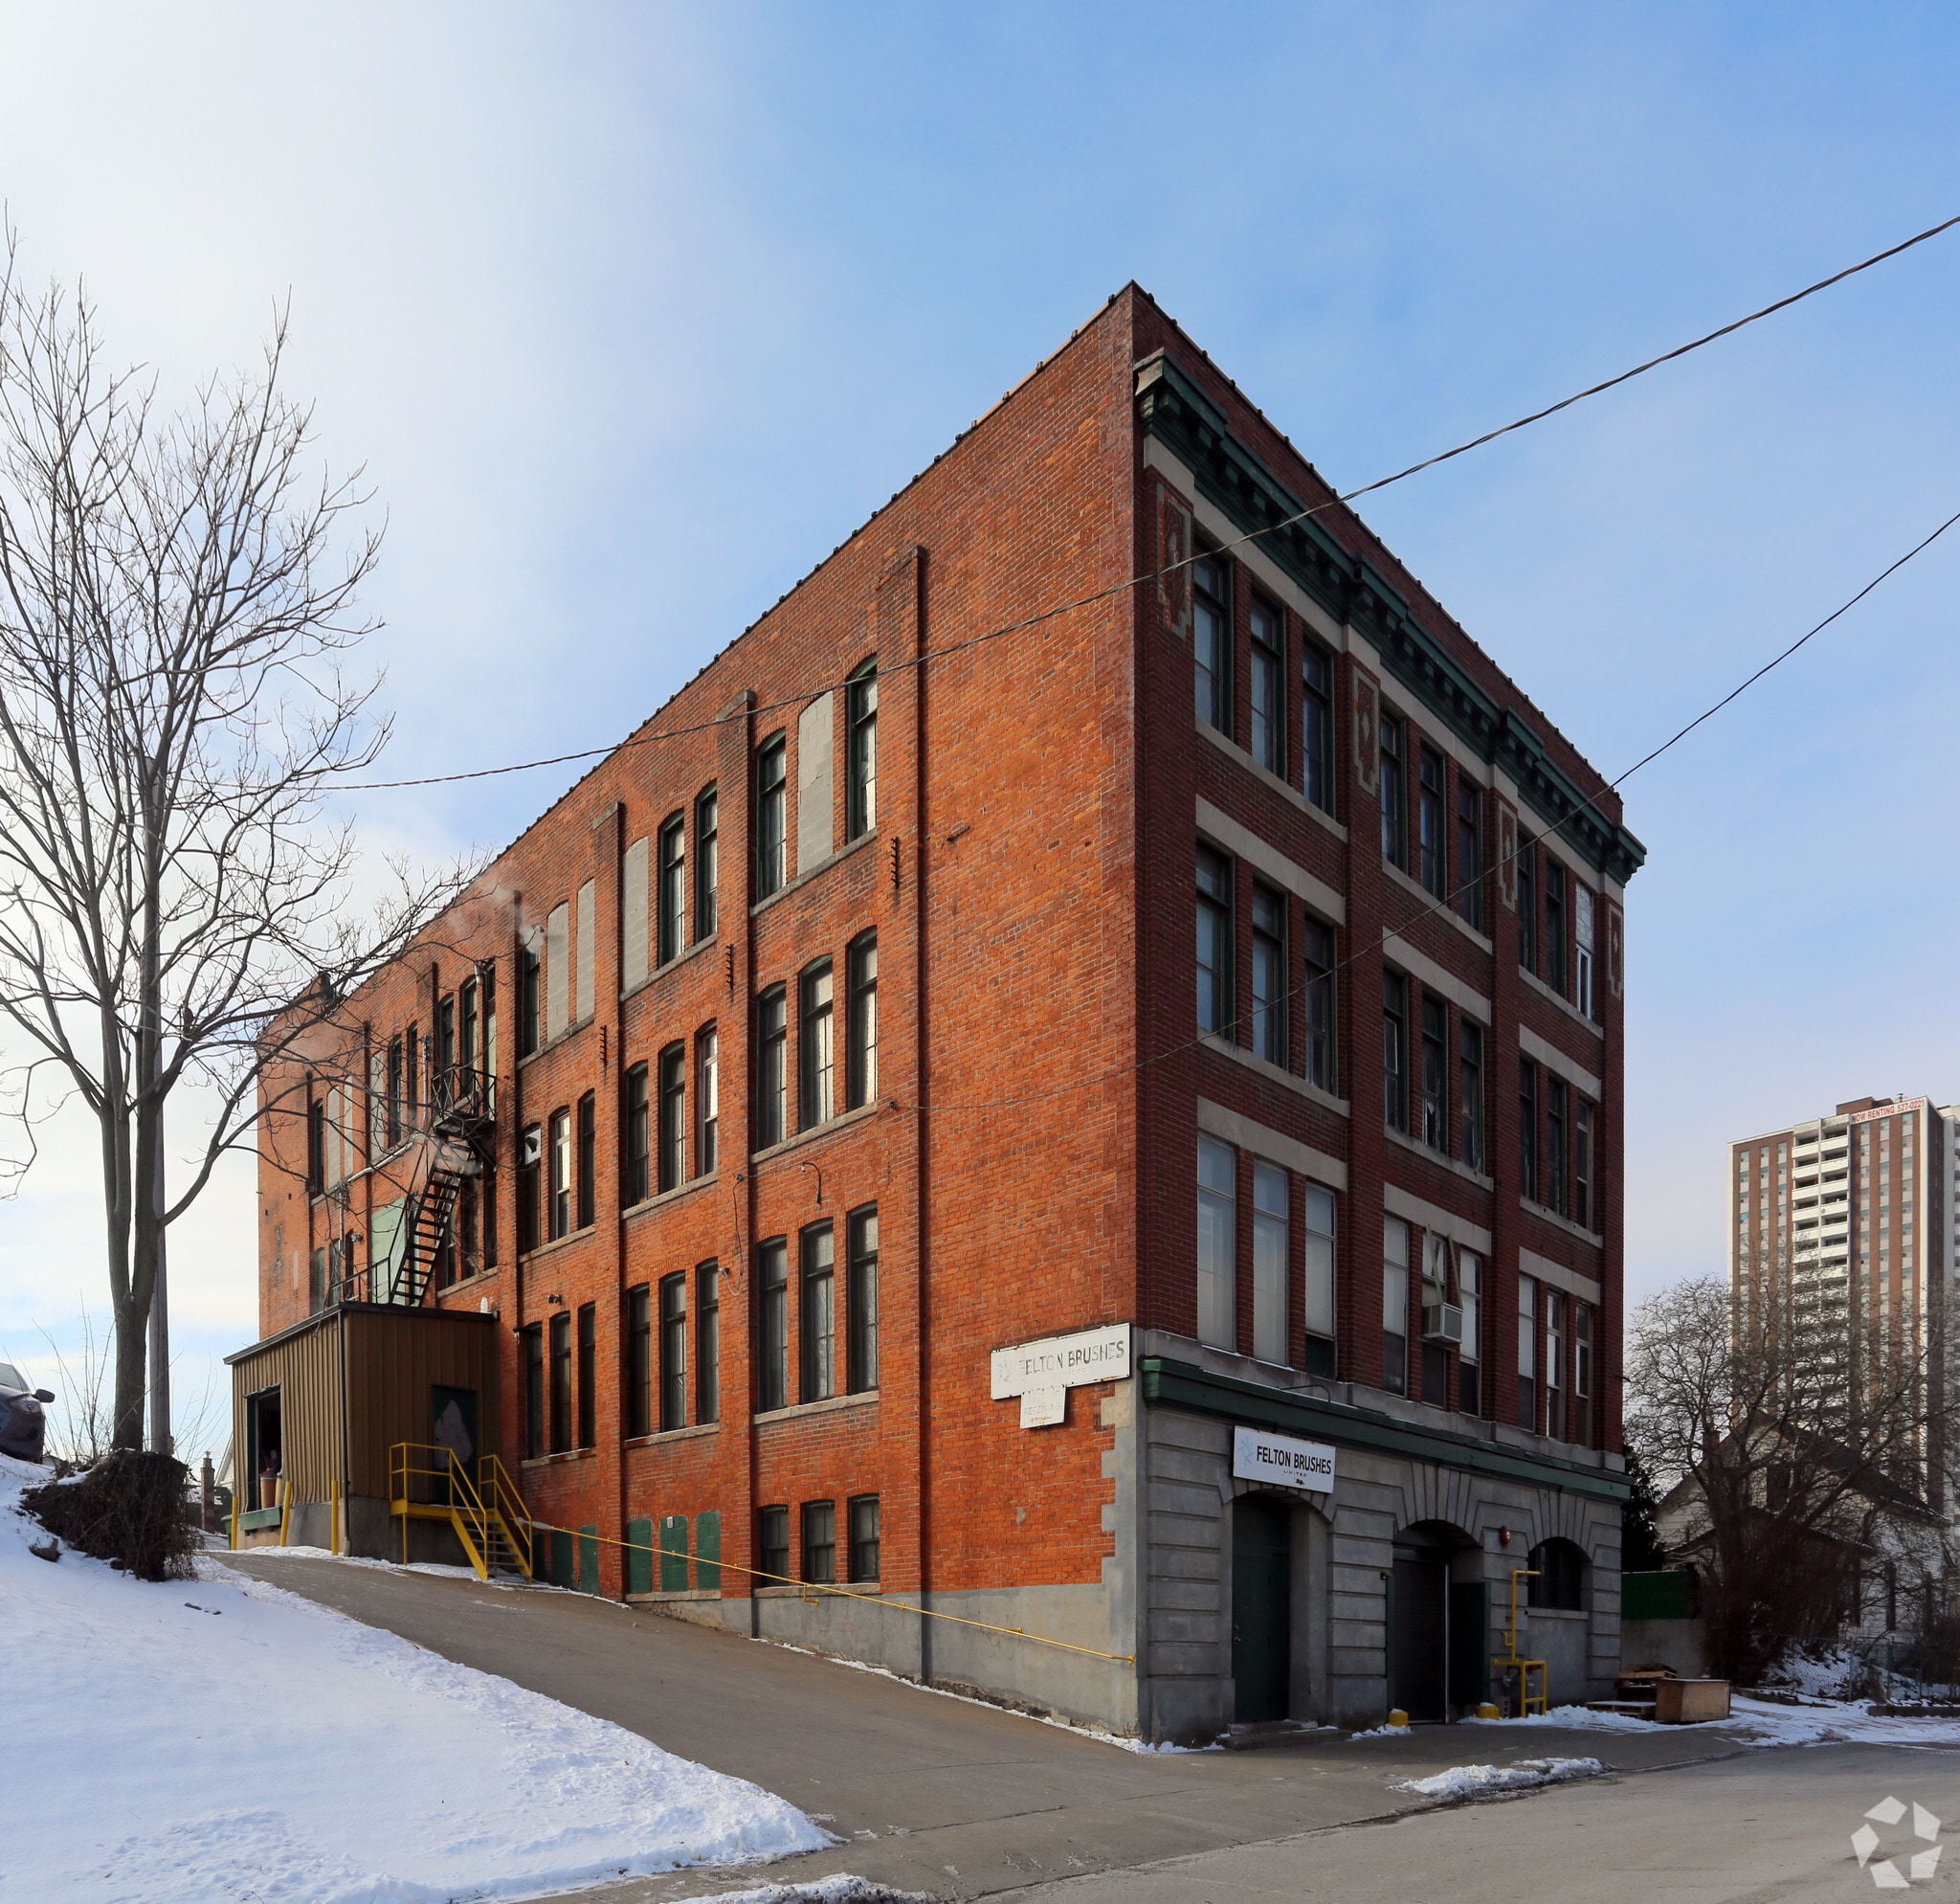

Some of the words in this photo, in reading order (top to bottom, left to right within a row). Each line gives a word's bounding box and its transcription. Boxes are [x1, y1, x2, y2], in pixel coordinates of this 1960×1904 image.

[1852, 1113, 1866, 1123] NOW
[1868, 1106, 1895, 1118] RENTING
[1068, 1340, 1125, 1368] BRUSHES
[1257, 1445, 1291, 1467] FELTON
[1294, 1453, 1331, 1474] BRUSHES
